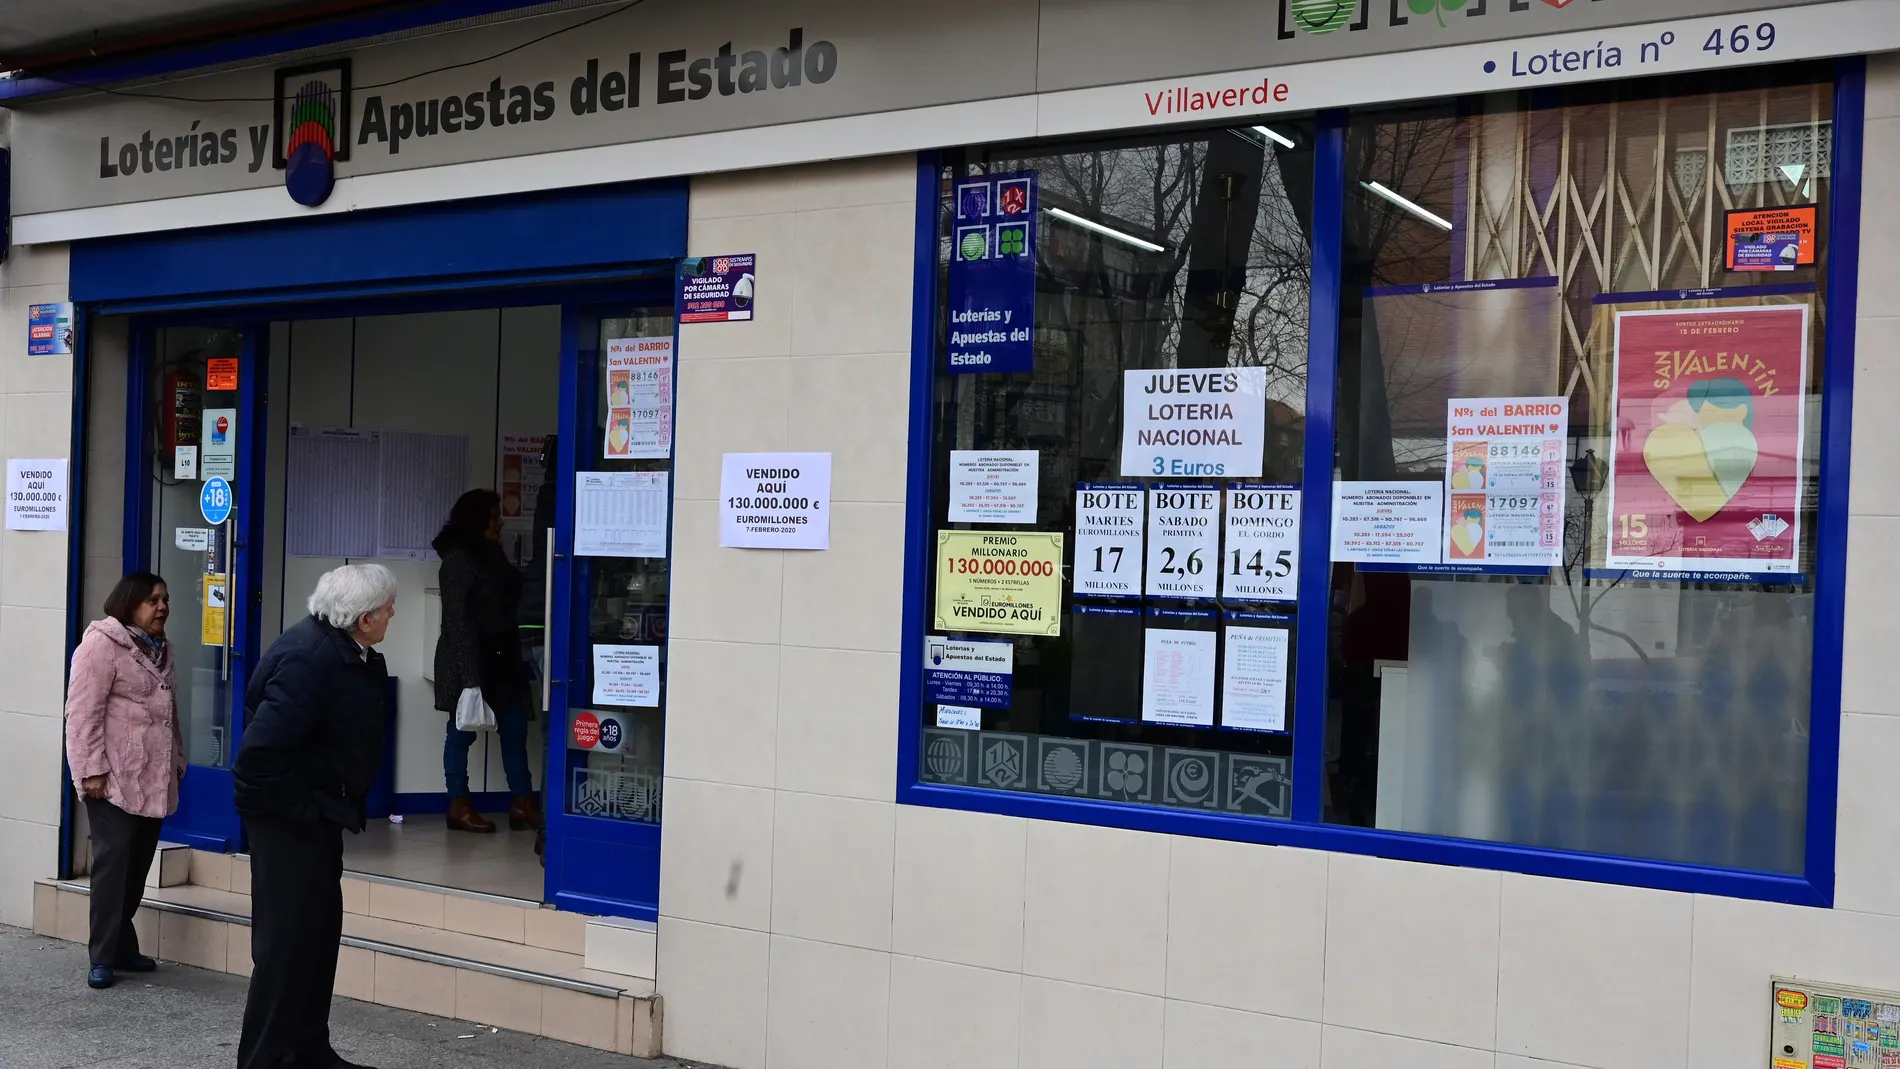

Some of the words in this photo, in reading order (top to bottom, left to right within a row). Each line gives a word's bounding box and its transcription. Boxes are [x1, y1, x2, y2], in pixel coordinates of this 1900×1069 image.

[1512, 41, 1622, 77] Lotería
[1640, 31, 1675, 63] nº
[1702, 22, 1776, 56] 469
[1145, 78, 1289, 116] Villaverde
[100, 120, 237, 179] Loterías
[248, 123, 270, 173] y
[357, 76, 556, 155] Apuestas
[570, 51, 641, 116] del
[656, 27, 839, 105] Estado
[698, 282, 729, 291] CÁMARAS
[693, 291, 729, 299] SEGURIDAD
[952, 308, 1000, 323] Loterías
[1004, 310, 1012, 324] y
[951, 330, 1006, 347] Apuestas
[1010, 327, 1029, 341] del
[639, 342, 670, 352] BARRIO
[624, 357, 660, 366] VALENTIN
[951, 351, 991, 365] Estado
[631, 372, 658, 381] 88146
[1654, 350, 1672, 389] SAN
[1673, 350, 1779, 398] VALENTÍN
[1144, 373, 1238, 394] JUEVES
[632, 410, 659, 418] 17097
[1148, 403, 1233, 420] LOTERIA
[1454, 408, 1474, 417] Nºs
[1480, 408, 1497, 417] del
[1504, 404, 1562, 416] BARRIO
[1452, 425, 1474, 436] San
[1477, 424, 1545, 436] VALENTIN
[1138, 429, 1242, 446] NACIONAL
[1490, 446, 1540, 456] 88146
[1152, 456, 1165, 476] 3
[1171, 459, 1224, 476] Euros
[746, 469, 800, 478] VENDIDO
[757, 481, 786, 493] AQUÍ
[10, 492, 56, 501] 130.000.000
[204, 488, 224, 506] +18
[1083, 493, 1137, 509] BOTE
[1156, 492, 1213, 509] BOTE
[1232, 493, 1293, 510] BOTE
[728, 497, 808, 509] 130.000.000
[813, 501, 820, 509] €
[1490, 498, 1538, 508] 17097
[736, 516, 808, 524] EUROMILLONES
[1085, 516, 1133, 526] MARTES
[1159, 516, 1208, 526] SABADO
[1231, 517, 1294, 528] DOMINGO
[1619, 514, 1648, 538] 15
[983, 537, 1017, 546] PREMIO
[972, 548, 1028, 557] MILLONARIO
[1092, 546, 1124, 574] 17
[1160, 546, 1203, 580] 2,6
[1230, 548, 1292, 583] 14,5
[948, 558, 1054, 577] 130.000.000
[1632, 570, 1650, 579] Que
[1703, 572, 1752, 581] acompañe.
[1085, 581, 1129, 590] MILLONES
[1158, 583, 1204, 592] MILLONES
[1235, 586, 1283, 594] MILLONES
[992, 601, 1033, 609] EUROMILLONES
[953, 606, 1006, 619] VENDIDO
[1011, 607, 1042, 621] AQUÍ
[932, 672, 963, 680] ATENCIÓN
[974, 674, 1003, 682] PÚBLICO:
[576, 720, 598, 728] Primera
[574, 727, 588, 735] regla
[602, 725, 618, 736] +18
